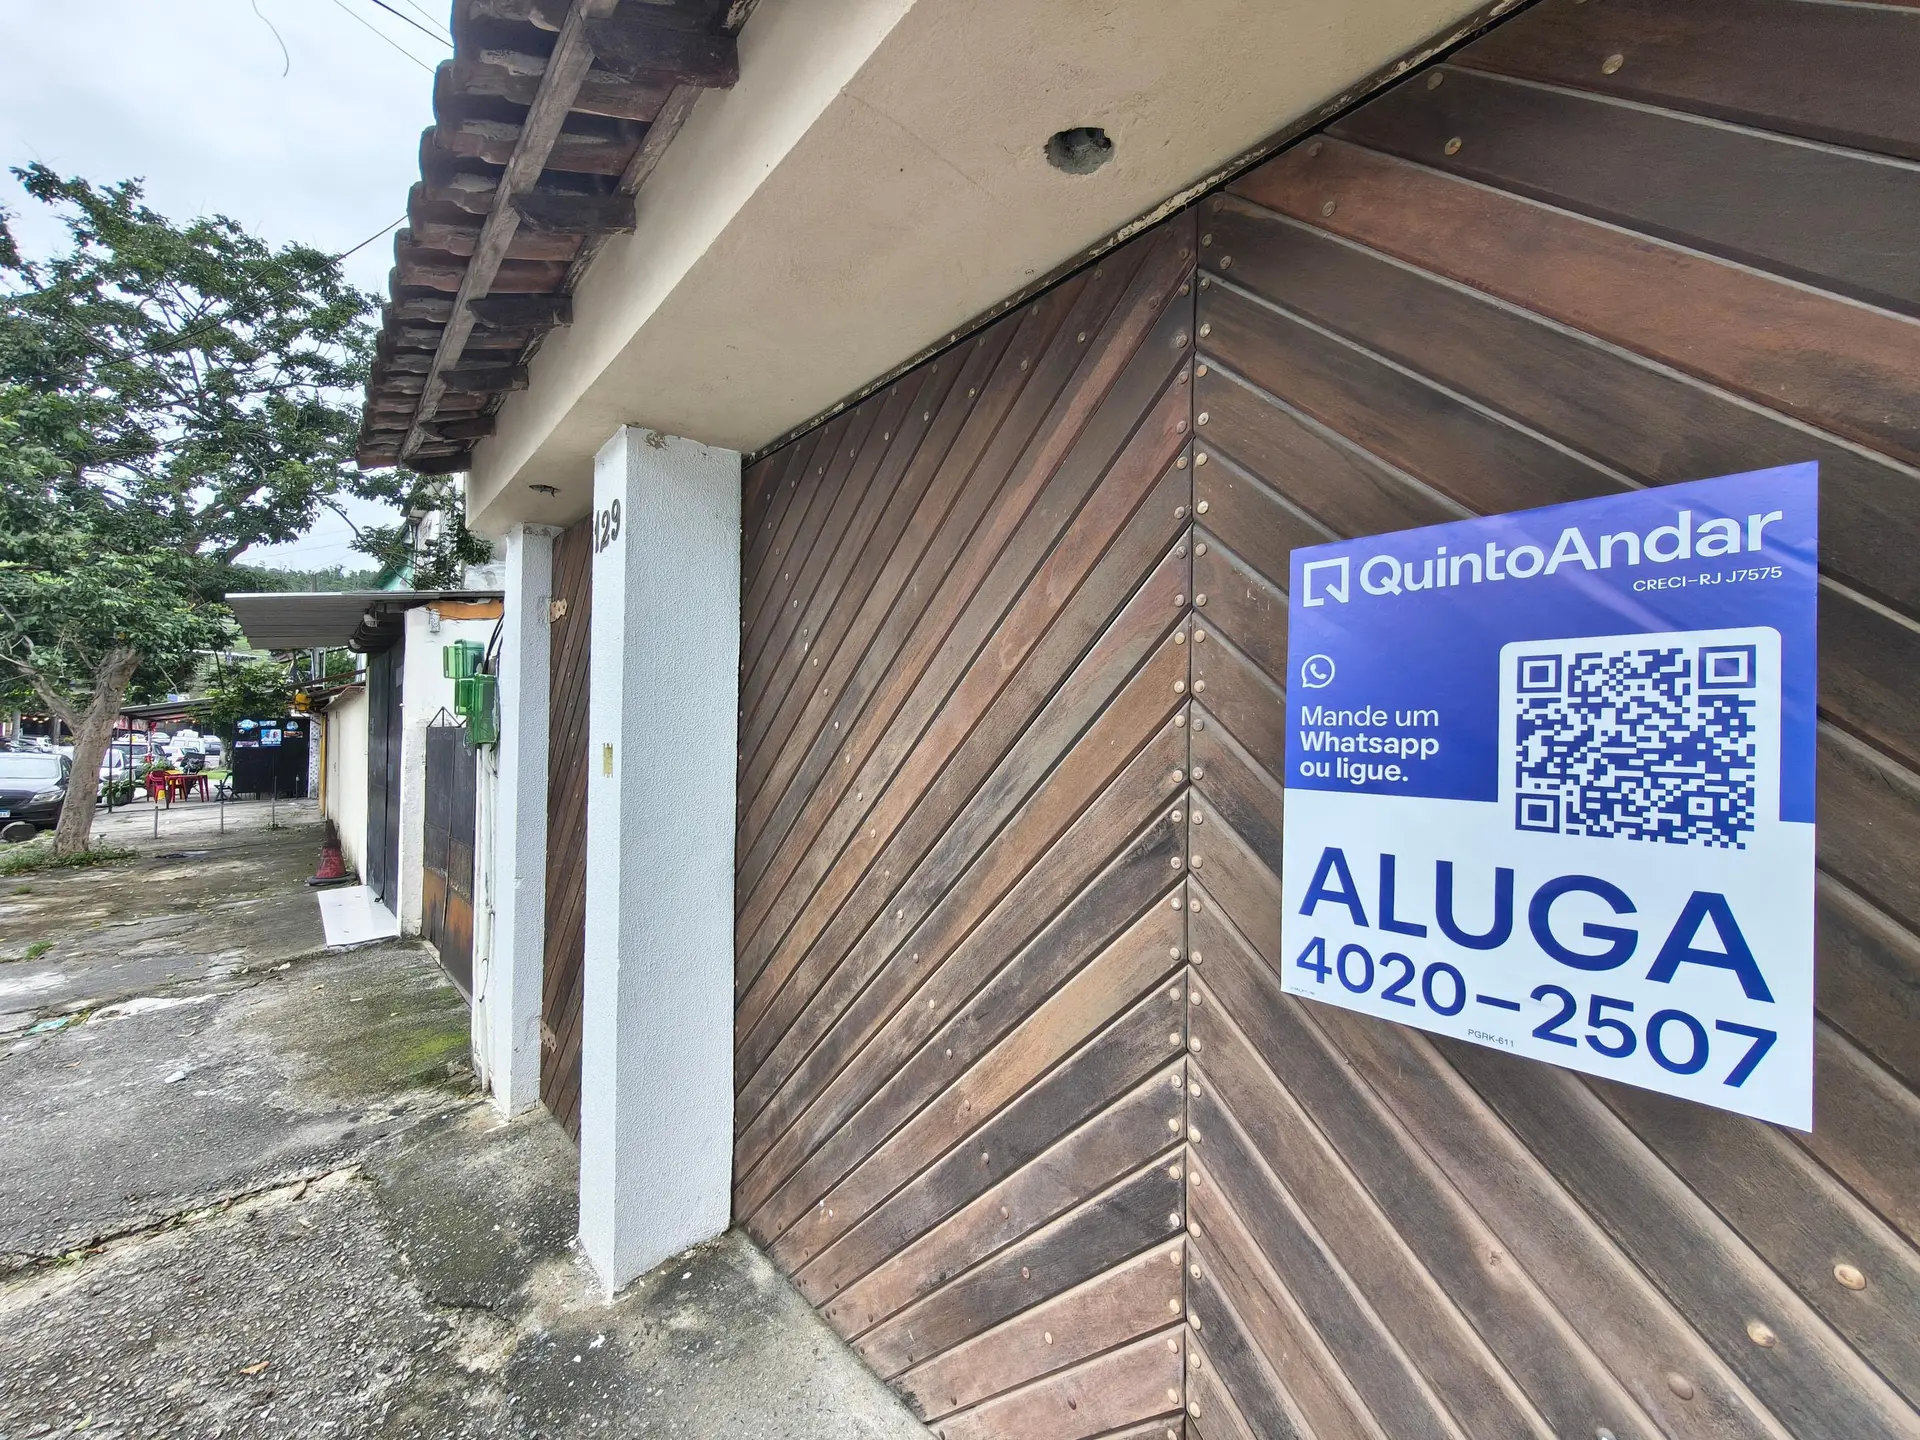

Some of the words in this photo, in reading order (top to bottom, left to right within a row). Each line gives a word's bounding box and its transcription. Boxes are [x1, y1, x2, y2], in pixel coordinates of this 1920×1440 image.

[595, 498, 621, 554] 129
[1360, 510, 1783, 596] QuintoAndar
[1633, 572, 1722, 592] CRECI-RJ
[1725, 565, 1783, 583] J7575
[1301, 705, 1388, 727] Mande
[1395, 709, 1439, 727] um
[1300, 730, 1440, 760] Whatsapp
[1300, 760, 1330, 778] ou
[1336, 757, 1409, 785] ligue.
[1299, 846, 1776, 1004] ALUGA
[1296, 936, 1778, 1089] 4020-2507
[1468, 1028, 1515, 1047] PGRK-611
